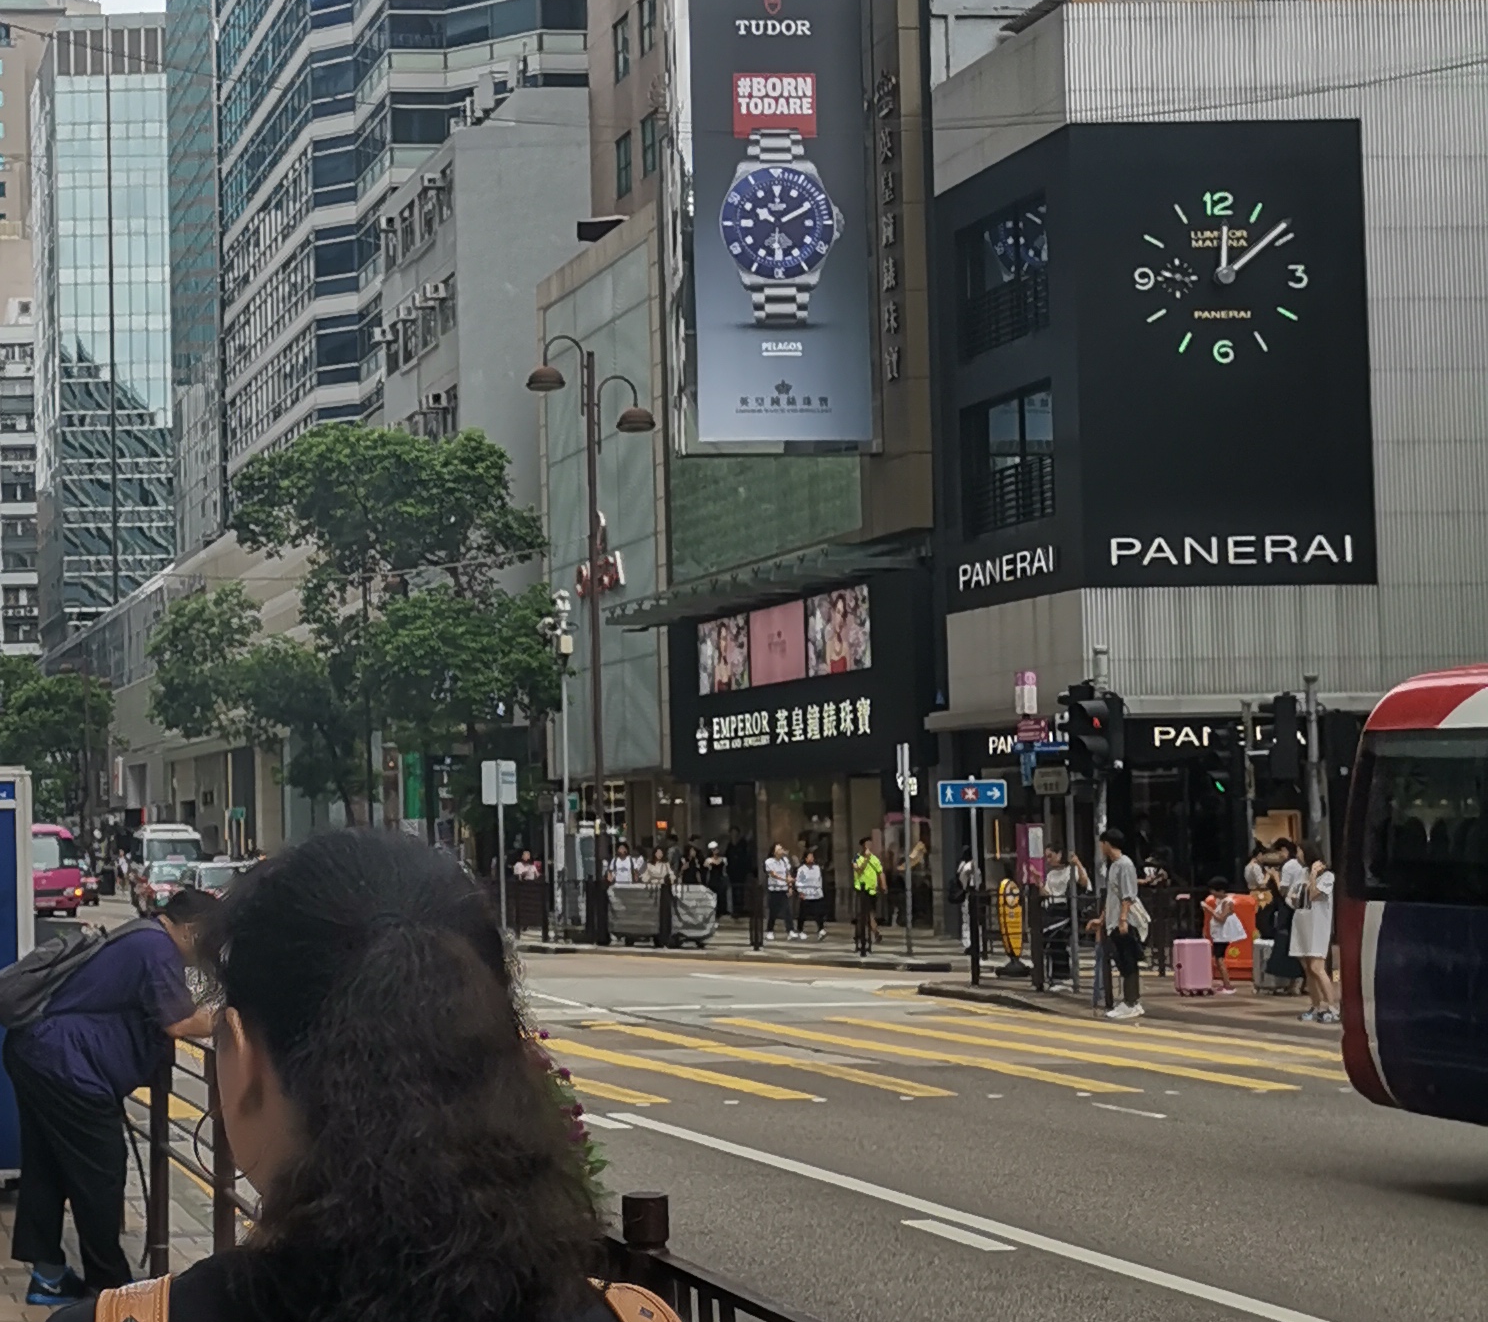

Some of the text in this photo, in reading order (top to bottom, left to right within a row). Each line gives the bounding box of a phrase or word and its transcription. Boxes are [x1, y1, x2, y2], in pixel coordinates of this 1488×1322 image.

[735, 19, 812, 36] TUDOR
[737, 77, 812, 97] #BORN
[738, 97, 813, 115] TODARE
[1202, 191, 1234, 216] 12
[1134, 267, 1155, 291] 9
[1287, 264, 1309, 289] 3
[1193, 310, 1252, 319] PANERAI
[1212, 339, 1235, 364] 6
[1110, 535, 1354, 566] PANERAI
[958, 544, 1054, 592] PANERAI
[712, 710, 770, 739] EMPEROR
